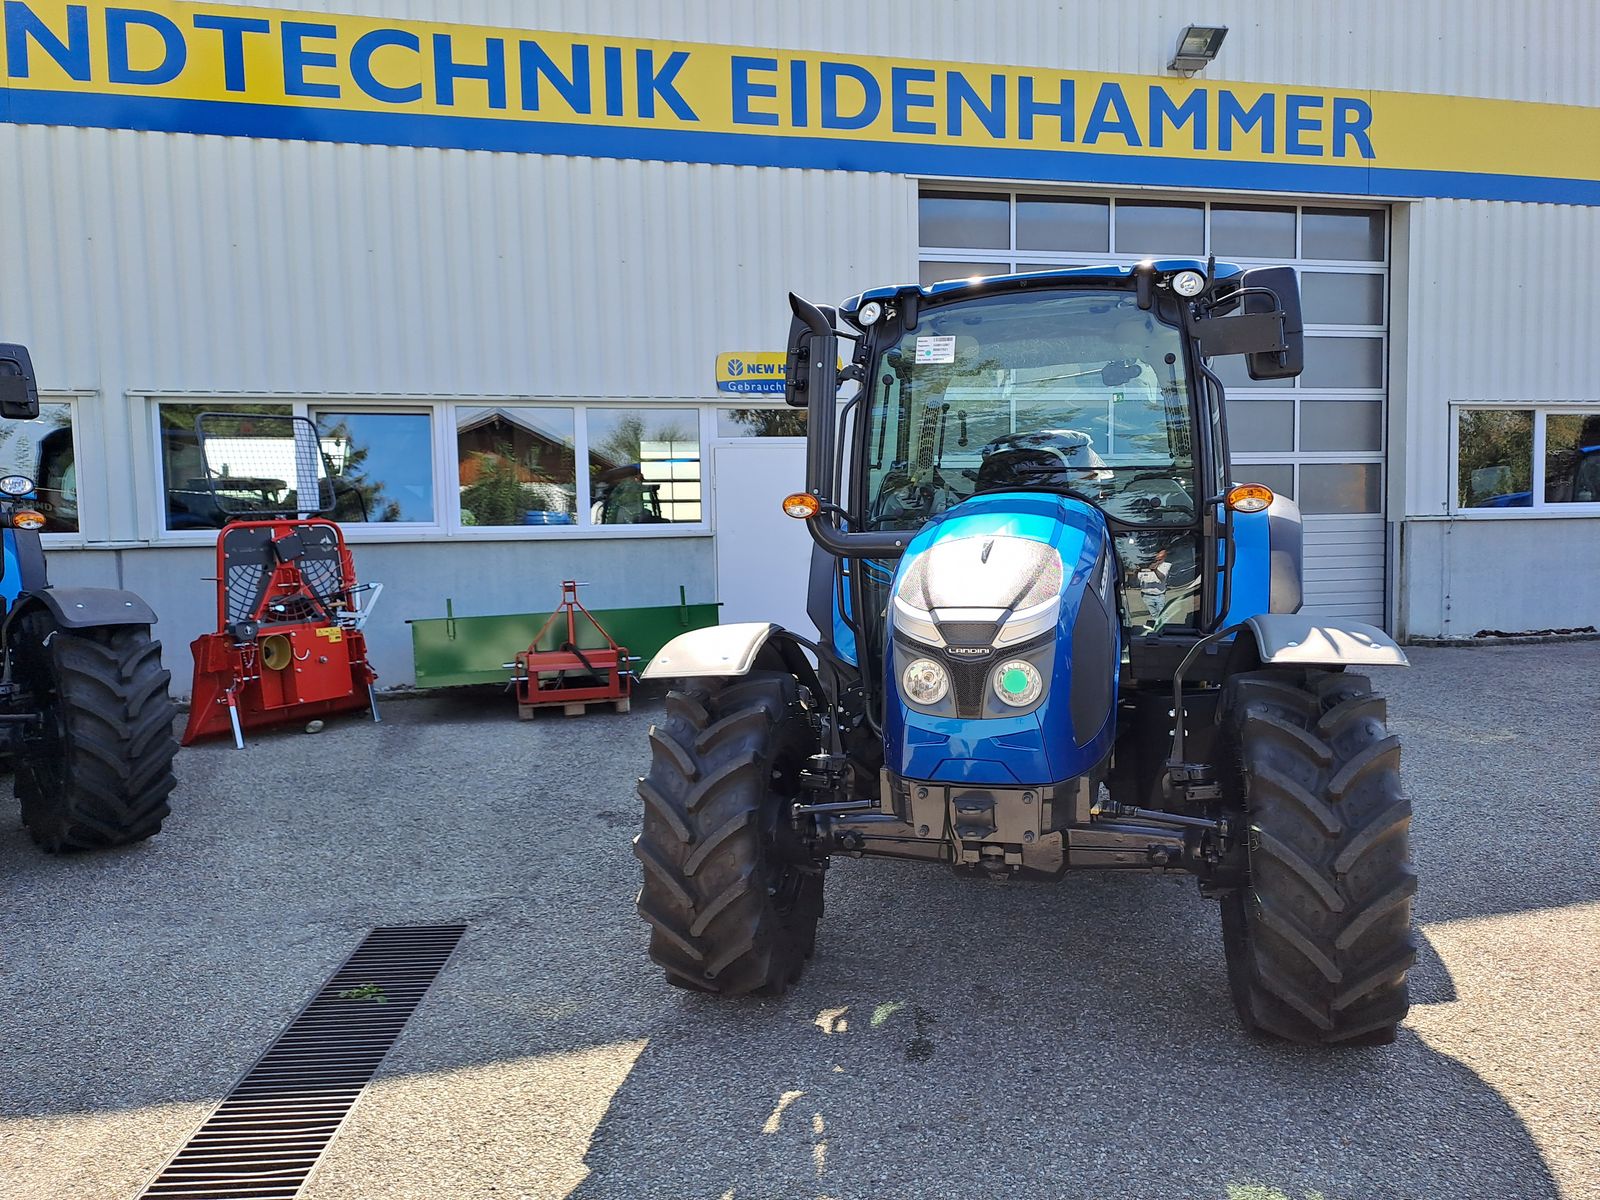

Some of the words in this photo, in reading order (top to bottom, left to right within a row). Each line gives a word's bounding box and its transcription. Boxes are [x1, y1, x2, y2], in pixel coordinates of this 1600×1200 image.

[6, 2, 698, 121] NDTECHNIK
[732, 57, 1376, 159] EIDENHAMMER
[747, 363, 775, 374] NEW
